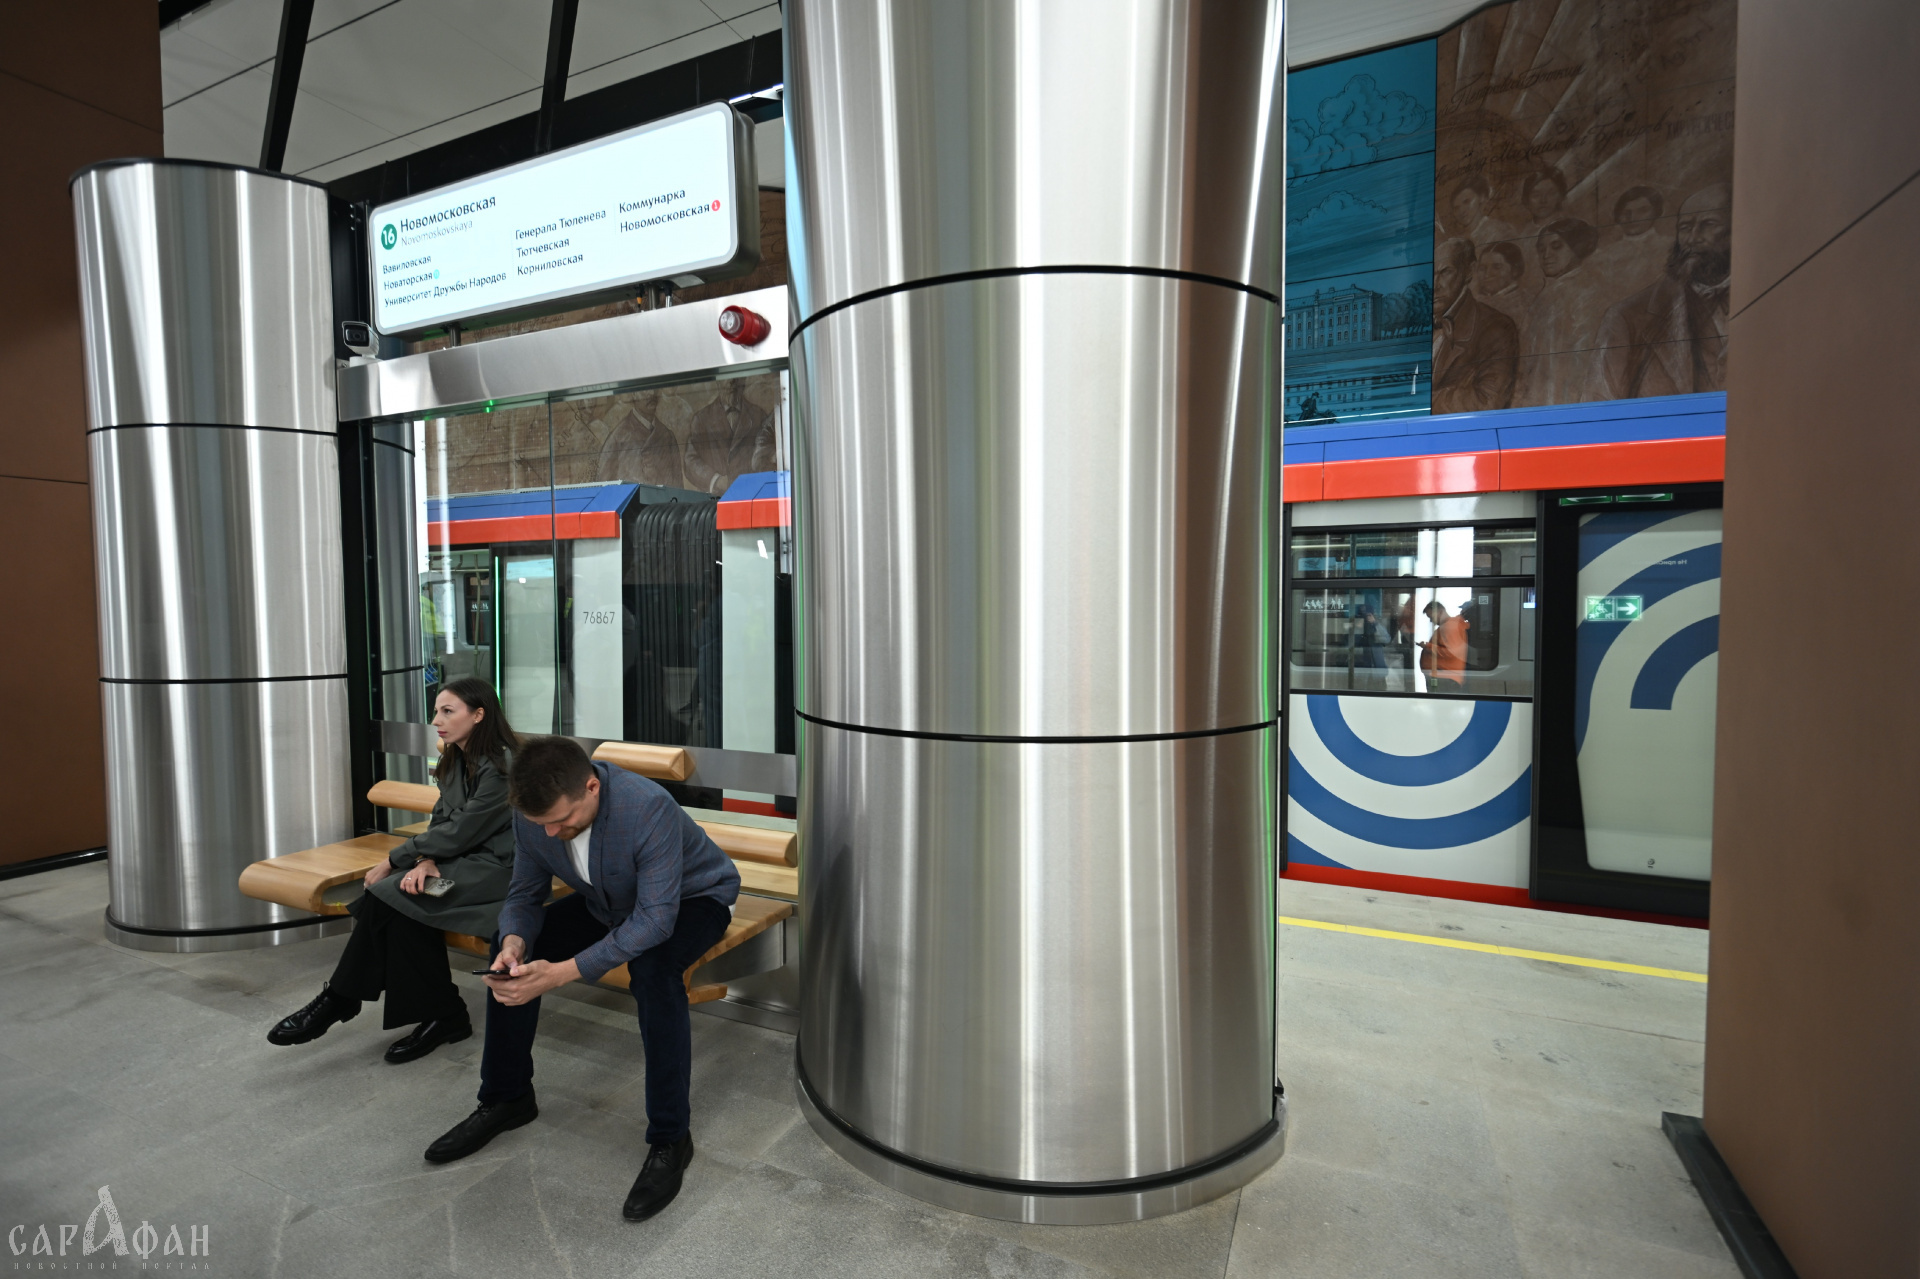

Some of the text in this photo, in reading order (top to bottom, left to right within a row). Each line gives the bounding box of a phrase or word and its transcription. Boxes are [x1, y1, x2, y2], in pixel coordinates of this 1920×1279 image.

[619, 189, 686, 214] Коммунарка
[400, 196, 496, 233] Новомосковская
[515, 209, 606, 240] Генерала Тюленева
[620, 203, 710, 233] Новомосковская
[382, 228, 396, 246] 16
[401, 220, 474, 247] Novomoskovskaya
[516, 238, 570, 258] Тютчевская
[383, 255, 432, 275] Вавиловская
[517, 254, 584, 276] Корниловская
[384, 272, 433, 291] Новаторская
[385, 272, 507, 308] Университет Дружбы Народов
[583, 611, 615, 624] 76867
